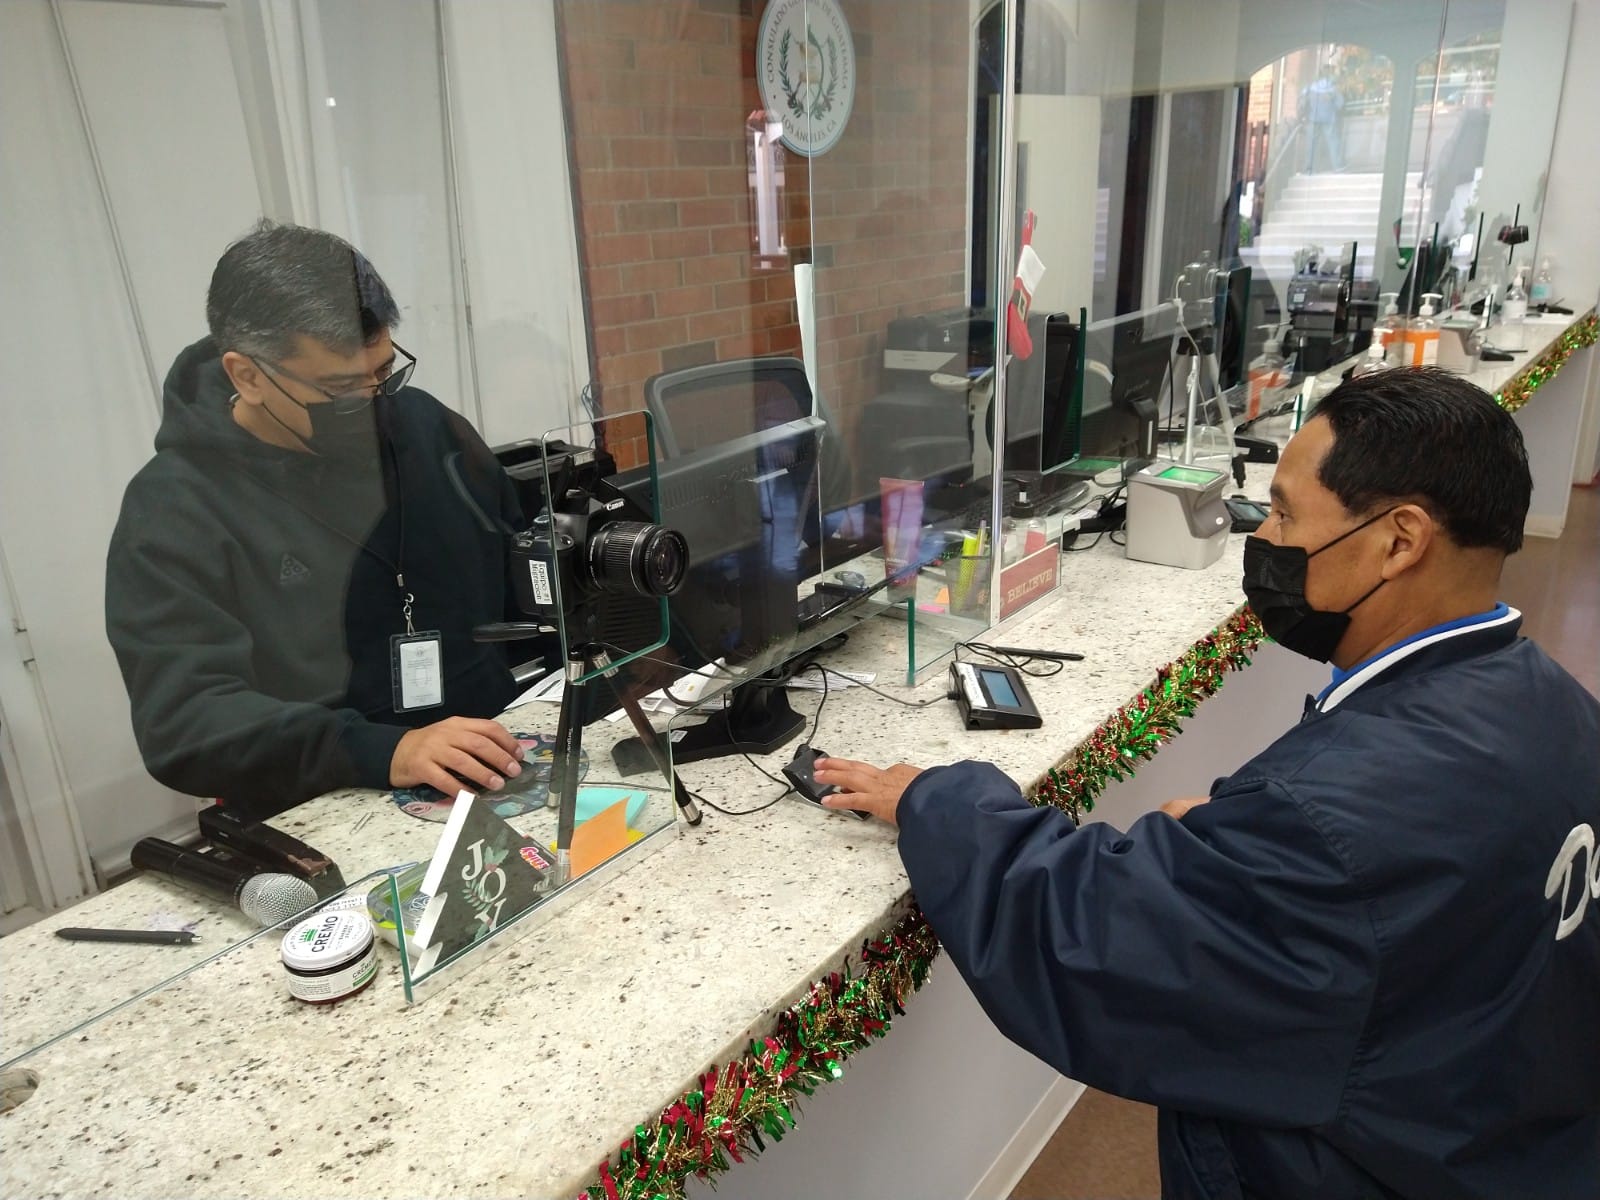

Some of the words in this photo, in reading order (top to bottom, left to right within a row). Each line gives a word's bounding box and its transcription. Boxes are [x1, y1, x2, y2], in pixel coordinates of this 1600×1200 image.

[767, 2, 788, 84] CONSULADO
[781, 114, 794, 134] LOS
[794, 127, 826, 143] ANGLES
[1007, 568, 1053, 603] BELIEVE
[461, 838, 507, 931] JOY
[311, 916, 338, 953] CREMO
